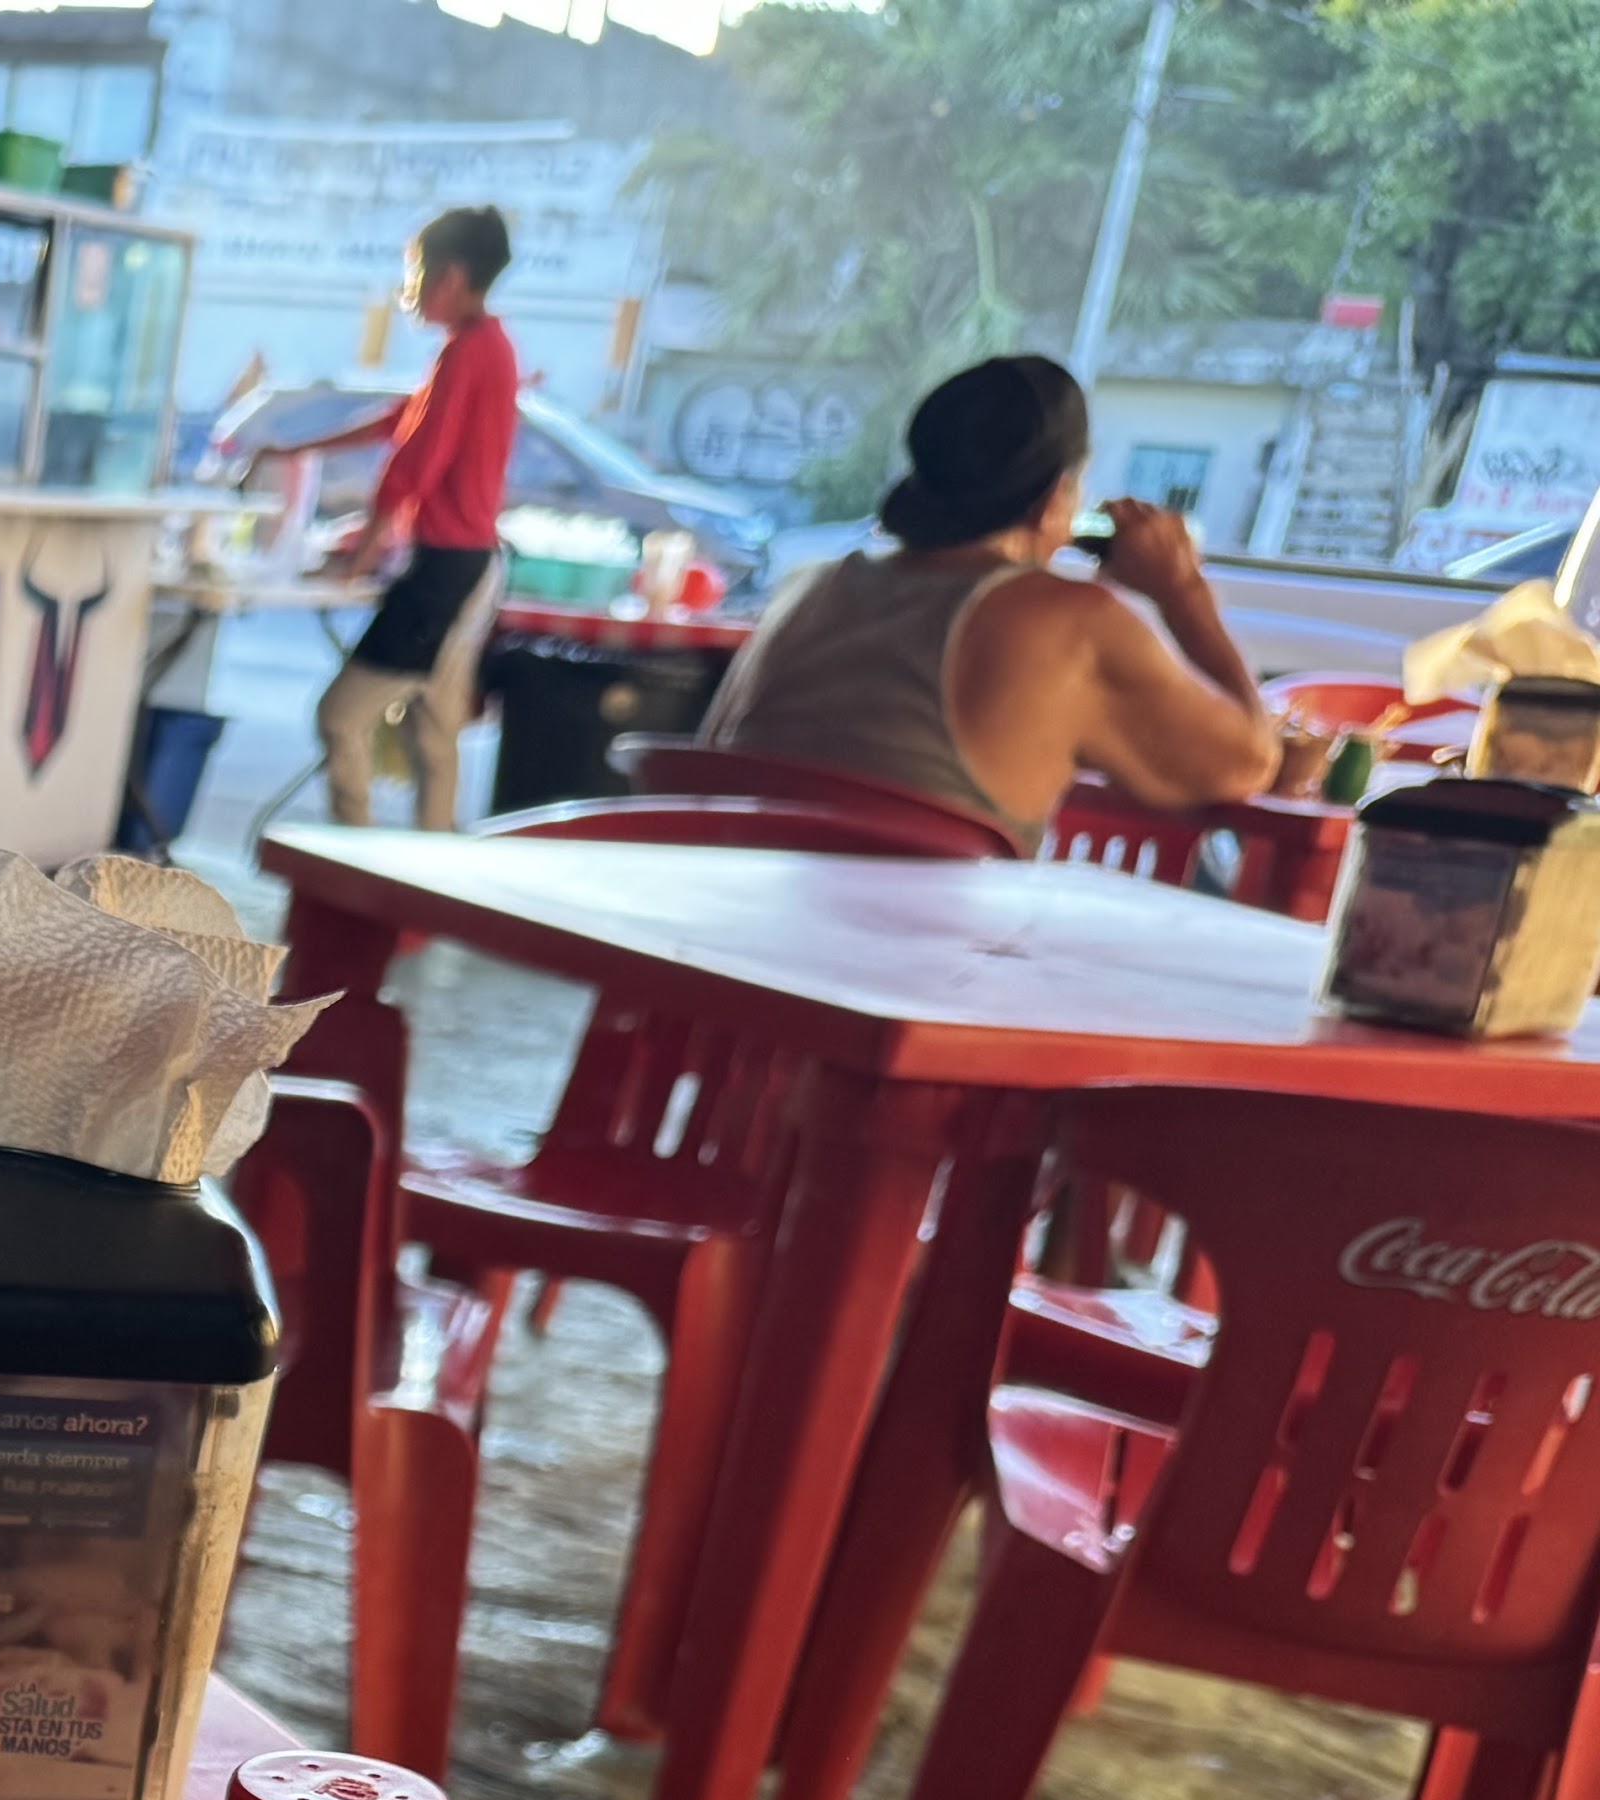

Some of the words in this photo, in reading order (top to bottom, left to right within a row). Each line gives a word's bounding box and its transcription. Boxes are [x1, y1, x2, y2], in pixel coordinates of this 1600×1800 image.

[63, 1412, 149, 1437] ahora?
[45, 1448, 129, 1471] siempre
[1, 1691, 76, 1718] Salud
[38, 1719, 64, 1738] EN
[68, 1720, 103, 1741] TUS
[0, 1736, 72, 1757] MANOS
